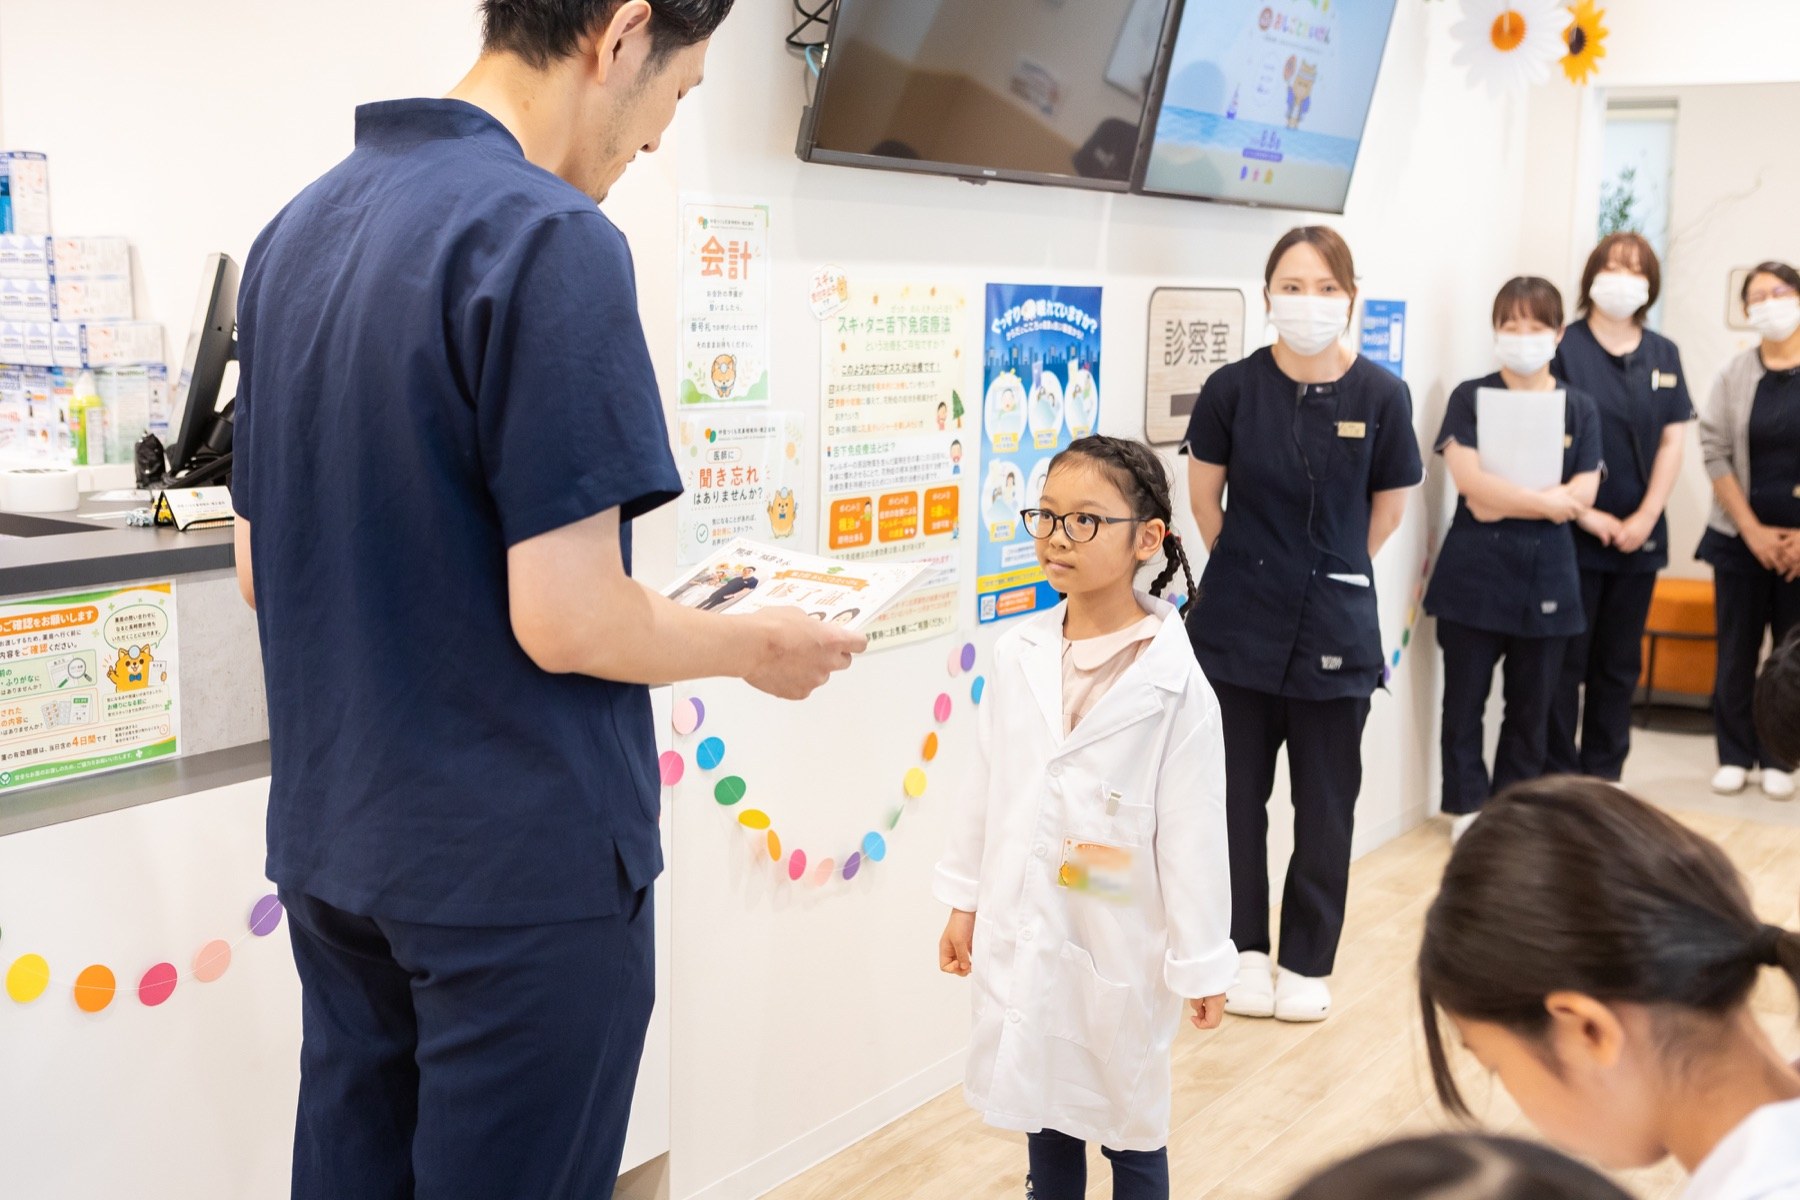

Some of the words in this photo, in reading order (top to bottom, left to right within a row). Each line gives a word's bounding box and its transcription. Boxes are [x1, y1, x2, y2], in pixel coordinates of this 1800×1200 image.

[701, 235, 752, 280] 会計
[991, 306, 1021, 334] ぐっすり
[1164, 319, 1229, 366] 診察室
[713, 450, 735, 461] 医師に
[833, 442, 896, 458] 舌下免疫療法とは?
[699, 466, 759, 489] 聞き忘れ
[693, 486, 763, 505] はありませんか?
[0, 610, 94, 632] ご確認をお願いします
